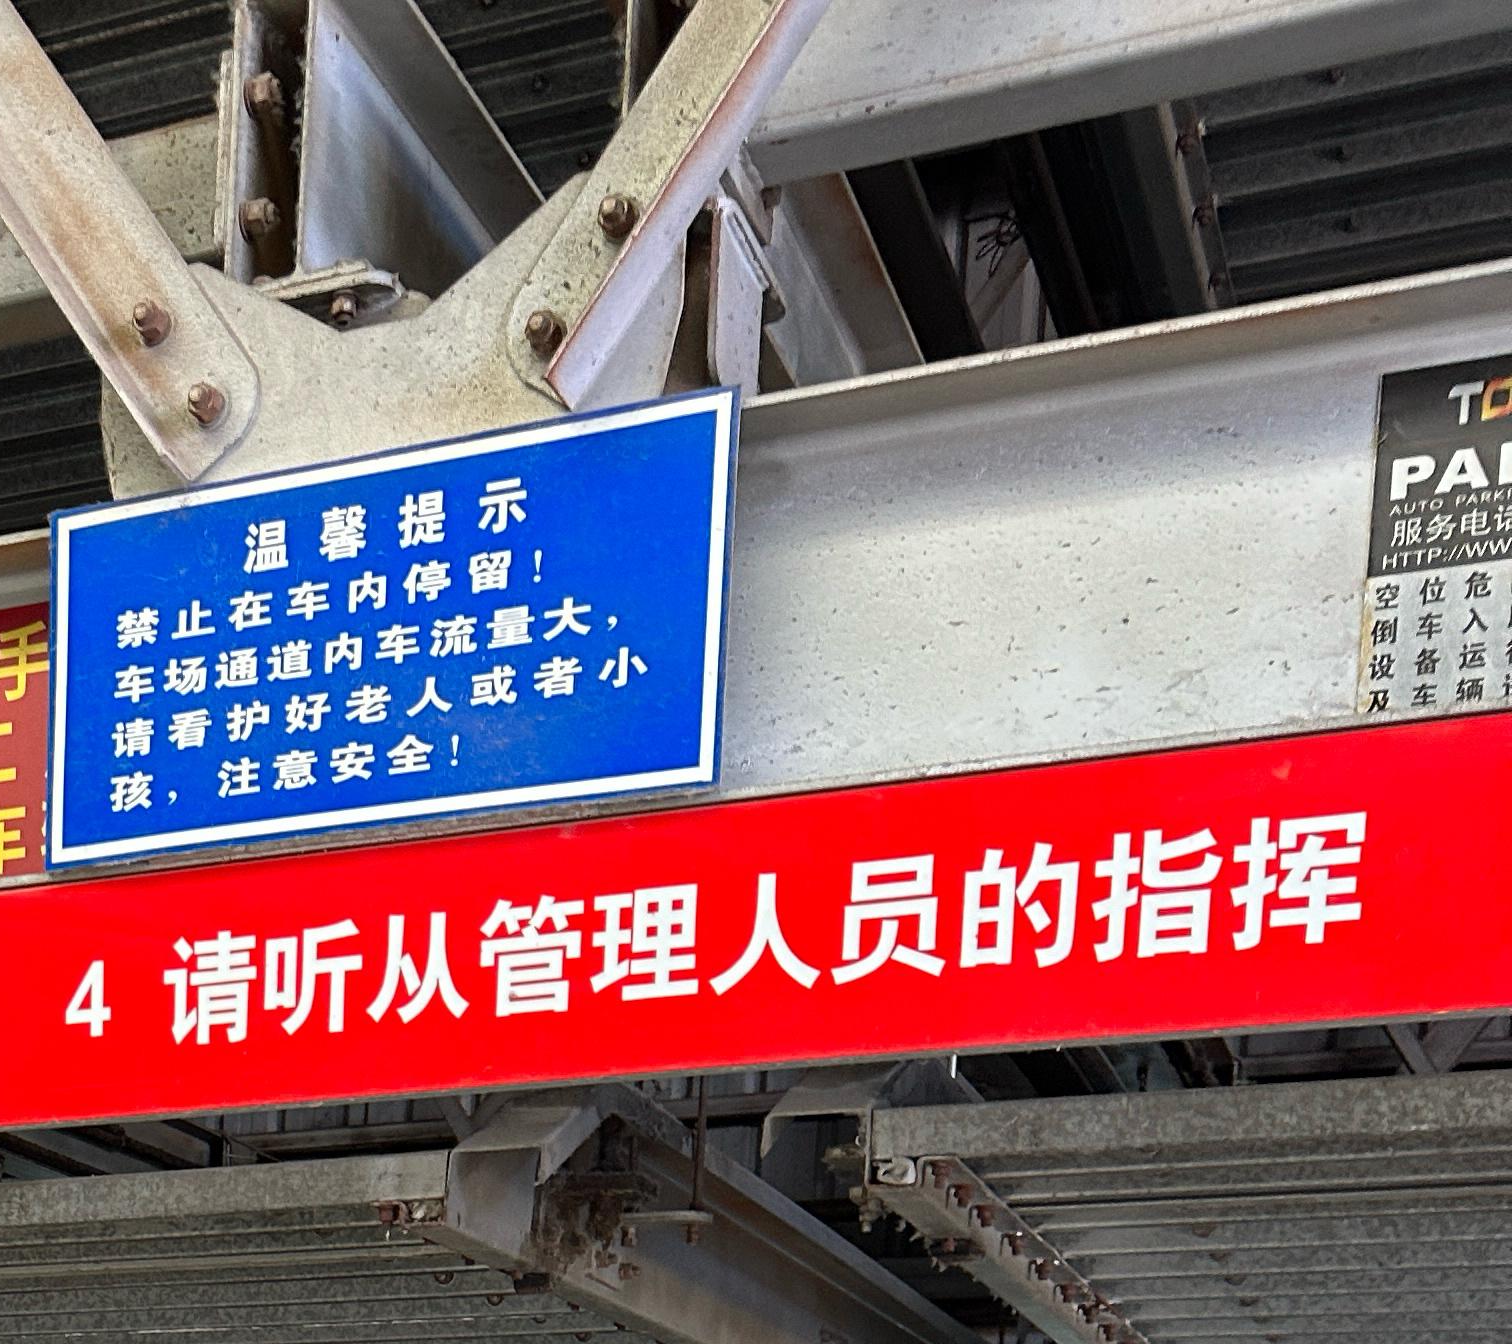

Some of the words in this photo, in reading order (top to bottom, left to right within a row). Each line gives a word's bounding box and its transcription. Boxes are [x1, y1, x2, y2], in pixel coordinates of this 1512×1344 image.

[244, 478, 528, 573] 温馨提示
[1390, 499, 1442, 517] AUTO
[116, 550, 543, 649] 禁止在车内停留！
[1371, 606, 1512, 647] 倒车入
[1375, 570, 1512, 612] 空位危
[114, 597, 620, 703] 车场通道内车流量大，
[1368, 639, 1512, 681] 设备运
[111, 647, 648, 760] 请看护好老人或者小
[111, 734, 460, 813] 孩，注意安全！
[65, 961, 112, 1038] 4
[164, 810, 1368, 1047] 请听从管理人员的指挥
